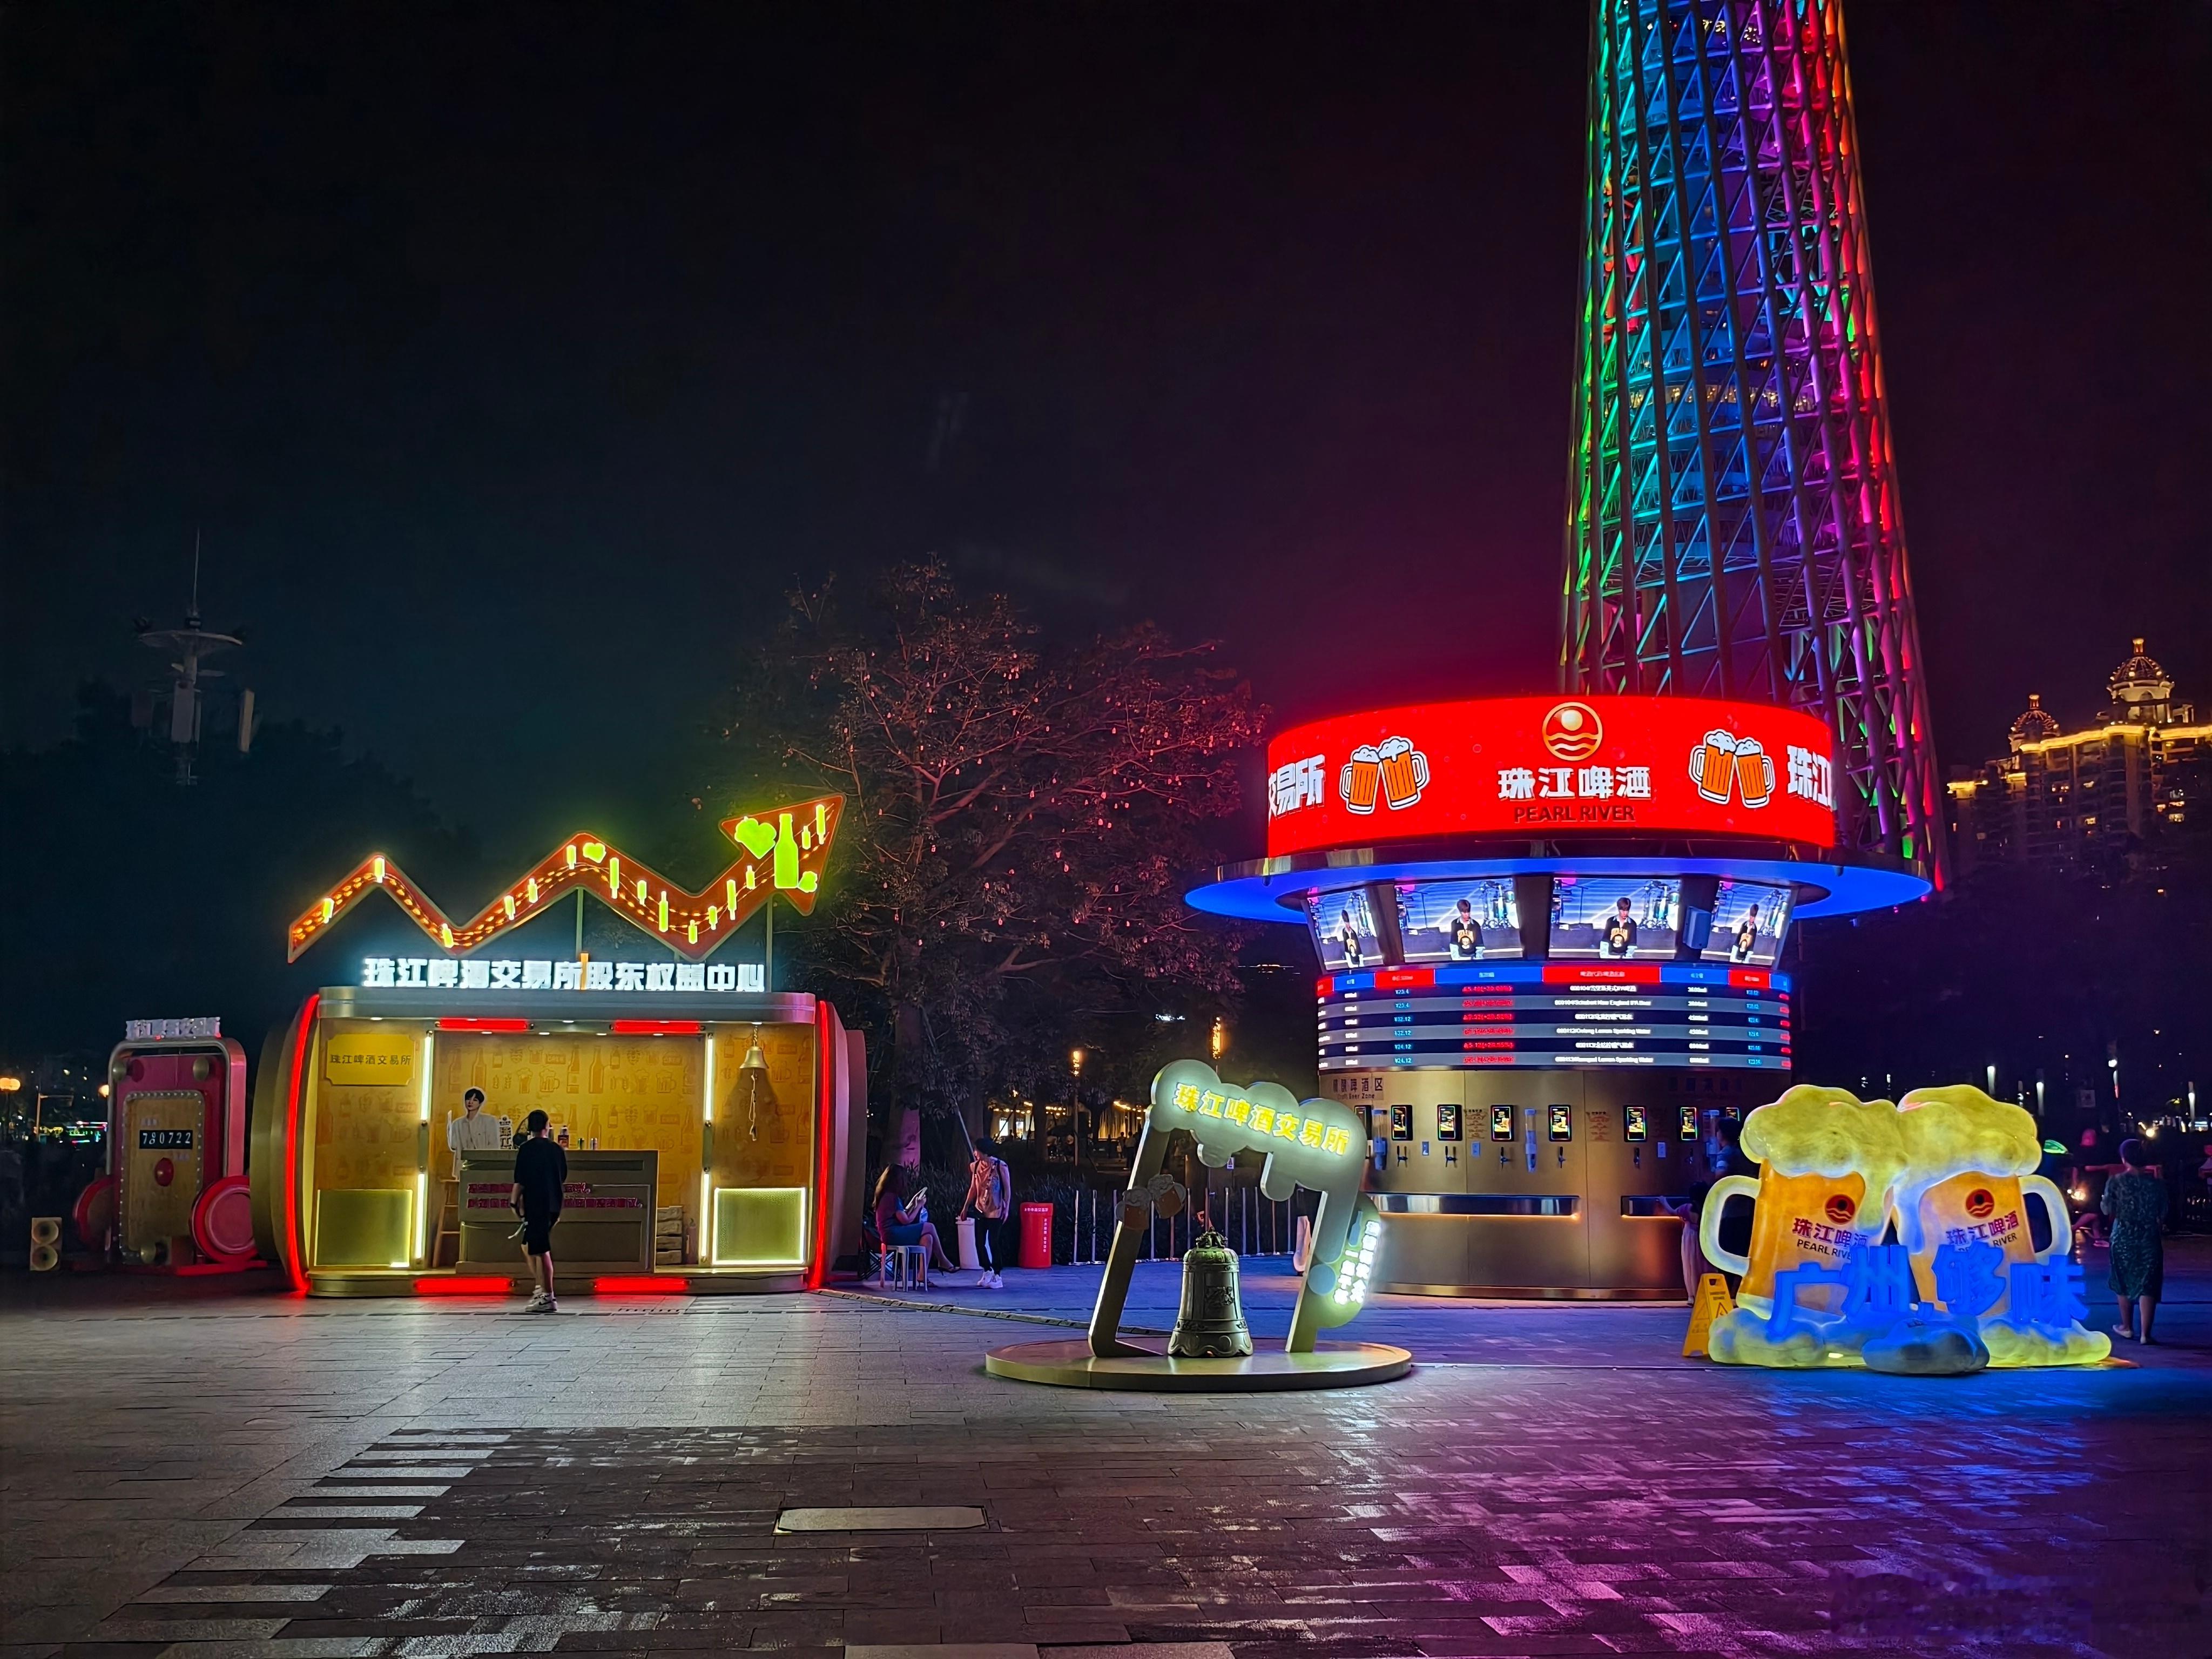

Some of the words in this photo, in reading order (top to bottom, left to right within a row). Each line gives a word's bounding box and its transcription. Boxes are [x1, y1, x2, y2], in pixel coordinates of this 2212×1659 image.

[1498, 765, 1651, 800] 珠江啤酒
[1786, 745, 1832, 812] 珠江
[1514, 806, 1577, 823] PEARL
[1580, 805, 1636, 822] RIVER
[329, 1054, 411, 1065] 珠江啤酒交易所
[1173, 1083, 1350, 1156] 珠江啤酒交易所
[143, 1132, 191, 1144] 780722
[1792, 1217, 1868, 1247] 珠江啤酒
[1945, 1210, 2020, 1245] 珠江啤酒
[1992, 1232, 2017, 1247] RIVER
[1797, 1239, 1830, 1256] PEARL
[1831, 1247, 1851, 1260] RIVE
